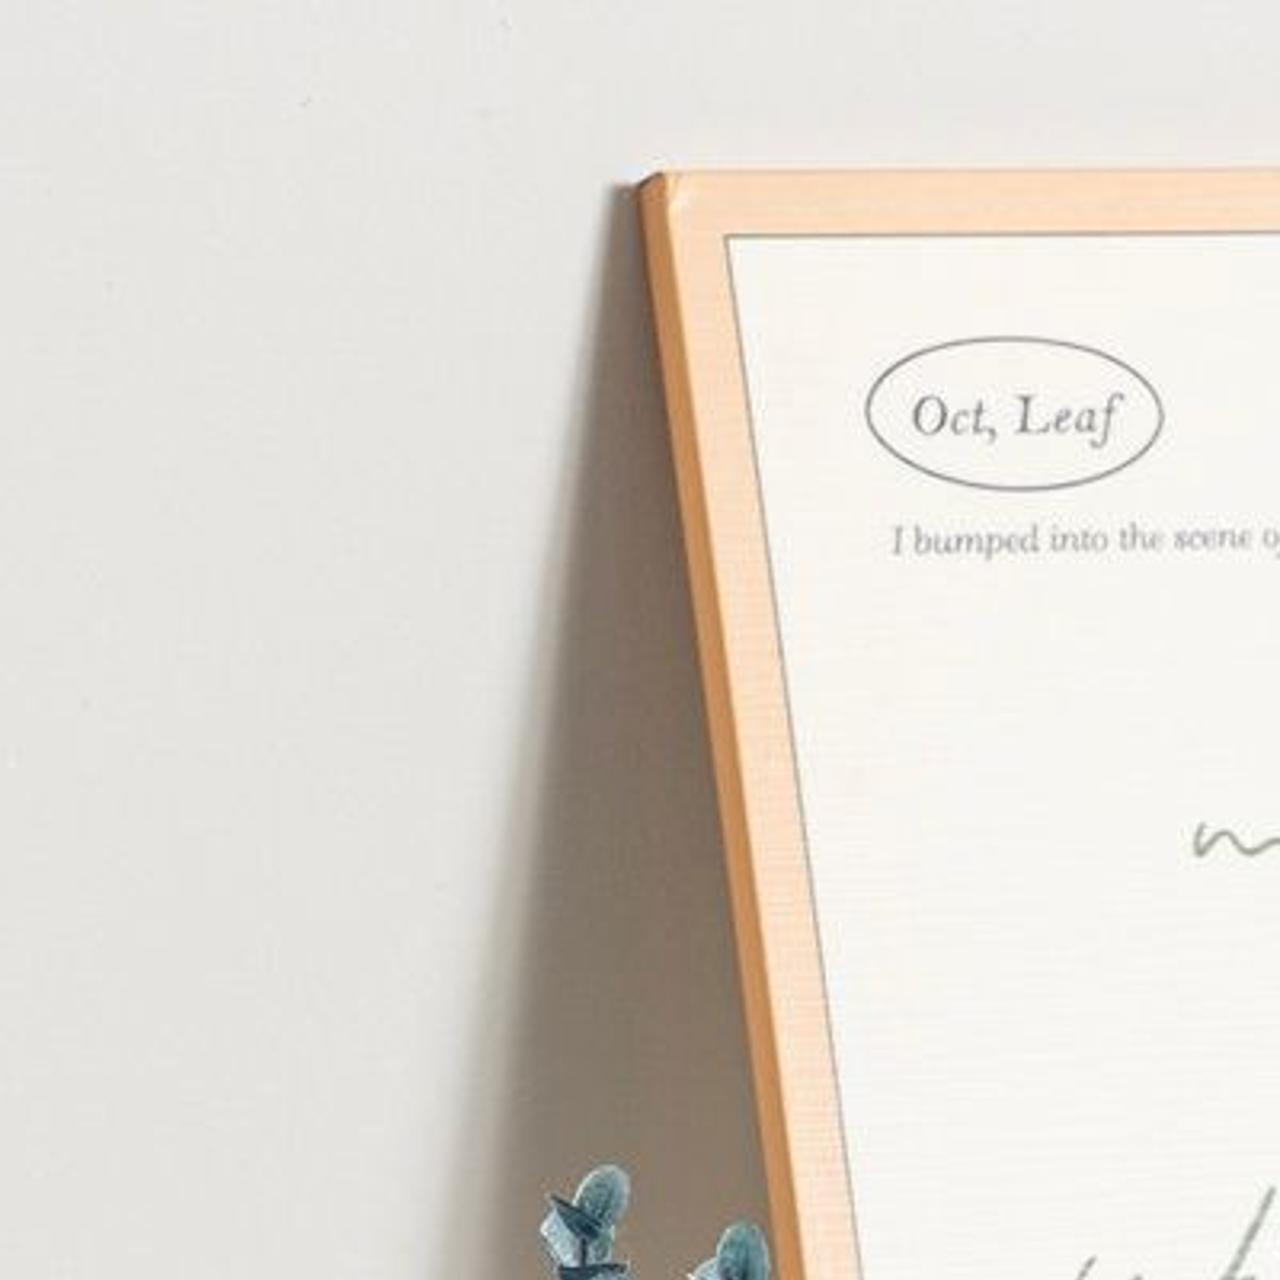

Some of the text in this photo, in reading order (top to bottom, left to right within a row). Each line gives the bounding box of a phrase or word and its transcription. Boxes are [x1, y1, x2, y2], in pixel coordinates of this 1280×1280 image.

[911, 391, 1126, 450] Oct, Leaf
[892, 525, 904, 556] I
[913, 523, 1041, 561] bumped
[1049, 525, 1110, 554] into
[1118, 521, 1163, 553] the
[1172, 528, 1253, 552] scene
